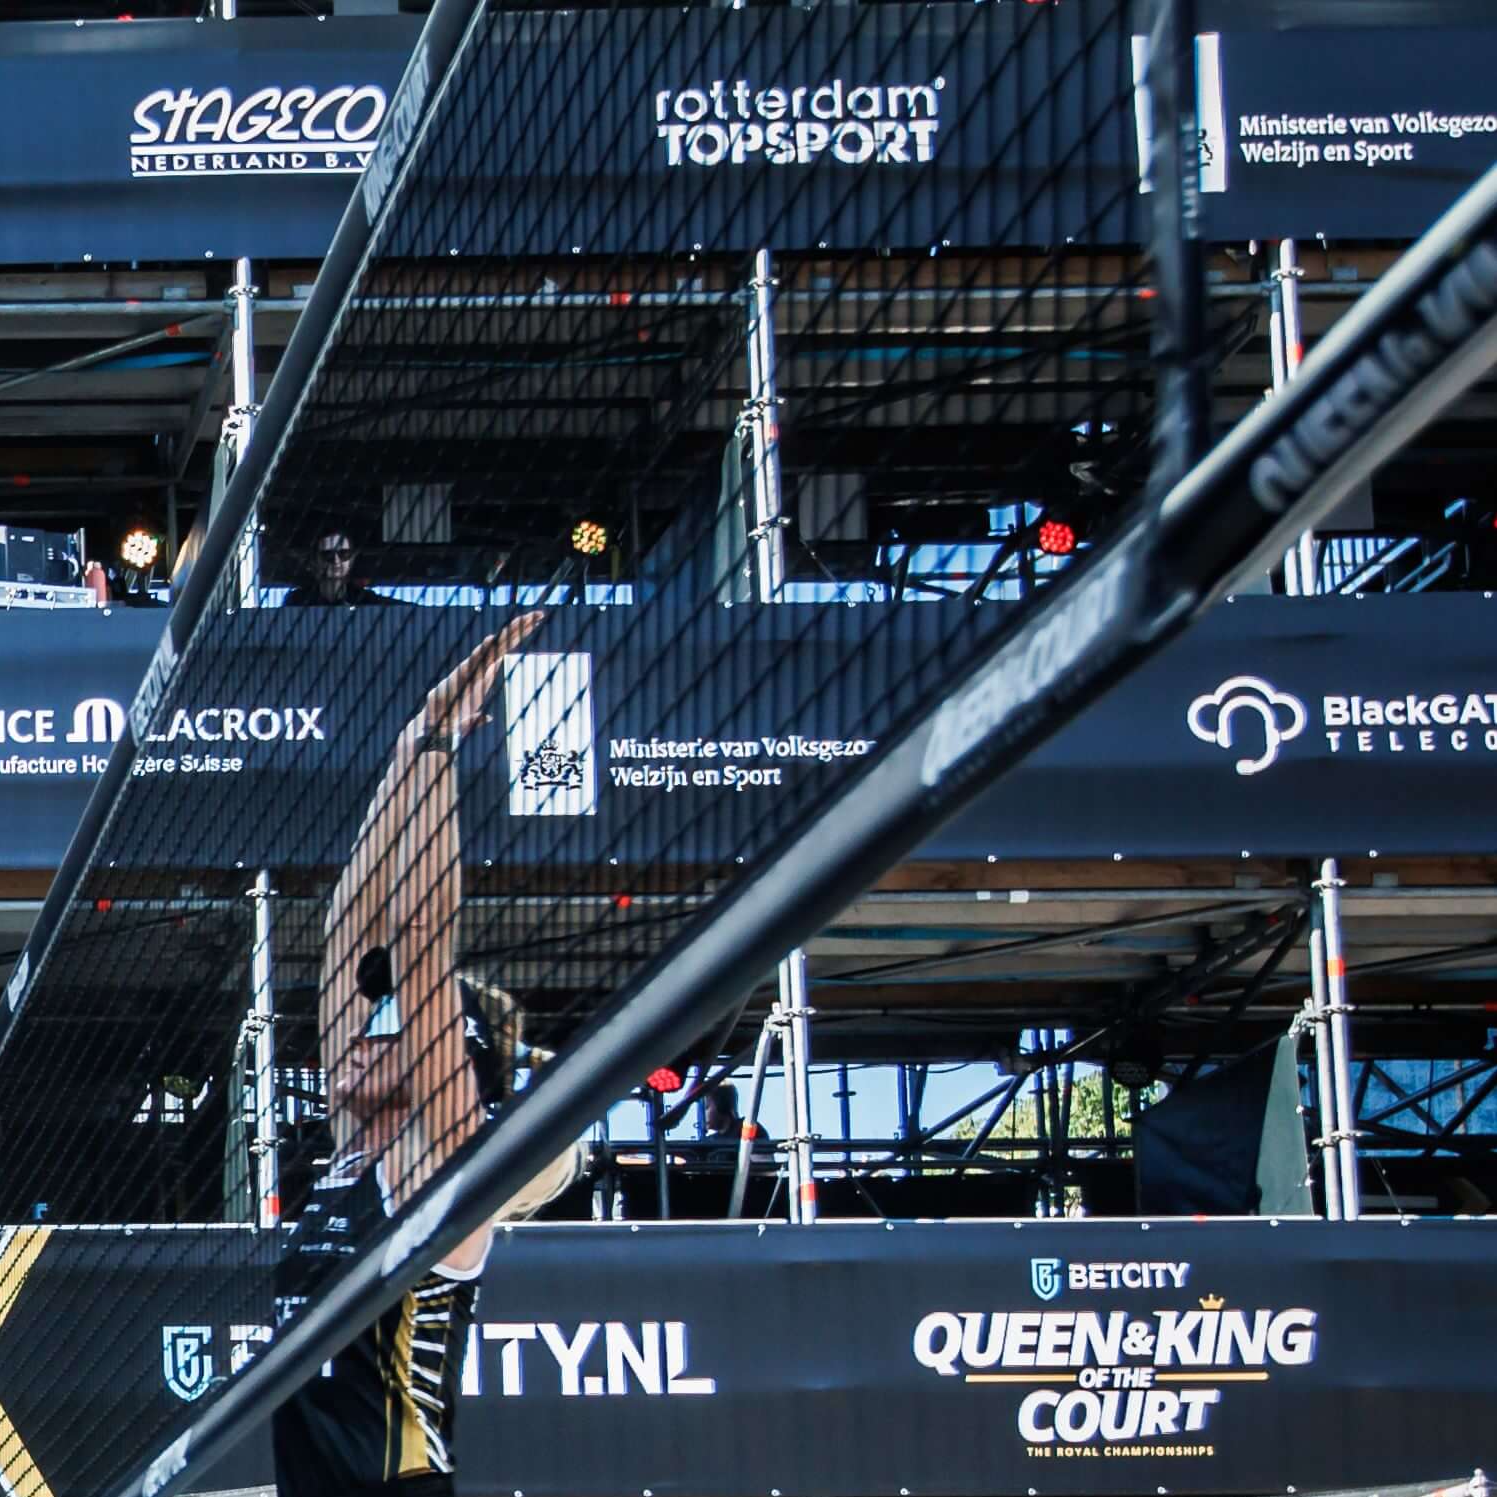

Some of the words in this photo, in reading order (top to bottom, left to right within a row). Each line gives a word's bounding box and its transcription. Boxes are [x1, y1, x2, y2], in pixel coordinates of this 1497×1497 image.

[1239, 113, 1348, 137] Ministerie
[1350, 117, 1389, 134] van
[657, 120, 938, 165] TOPSPORT
[1241, 140, 1318, 168] Welzijn
[1323, 144, 1352, 162] en
[1354, 141, 1413, 168] Sport
[131, 152, 305, 172] NEDERLAND
[609, 737, 716, 759] Ministerie
[718, 740, 759, 758] van
[180, 755, 243, 774] Suisse
[610, 764, 687, 792] Welzijn
[692, 768, 720, 786] en
[723, 767, 782, 792] Sport
[1068, 1262, 1190, 1290] BETCITY
[1079, 1367, 1110, 1389] OF
[1111, 1367, 1156, 1389] THE
[1018, 1388, 1221, 1443] COURT
[1027, 1447, 1052, 1457] THE
[1057, 1447, 1099, 1457] ROYAL
[1104, 1446, 1215, 1457] CHAMPIONSHIPS
